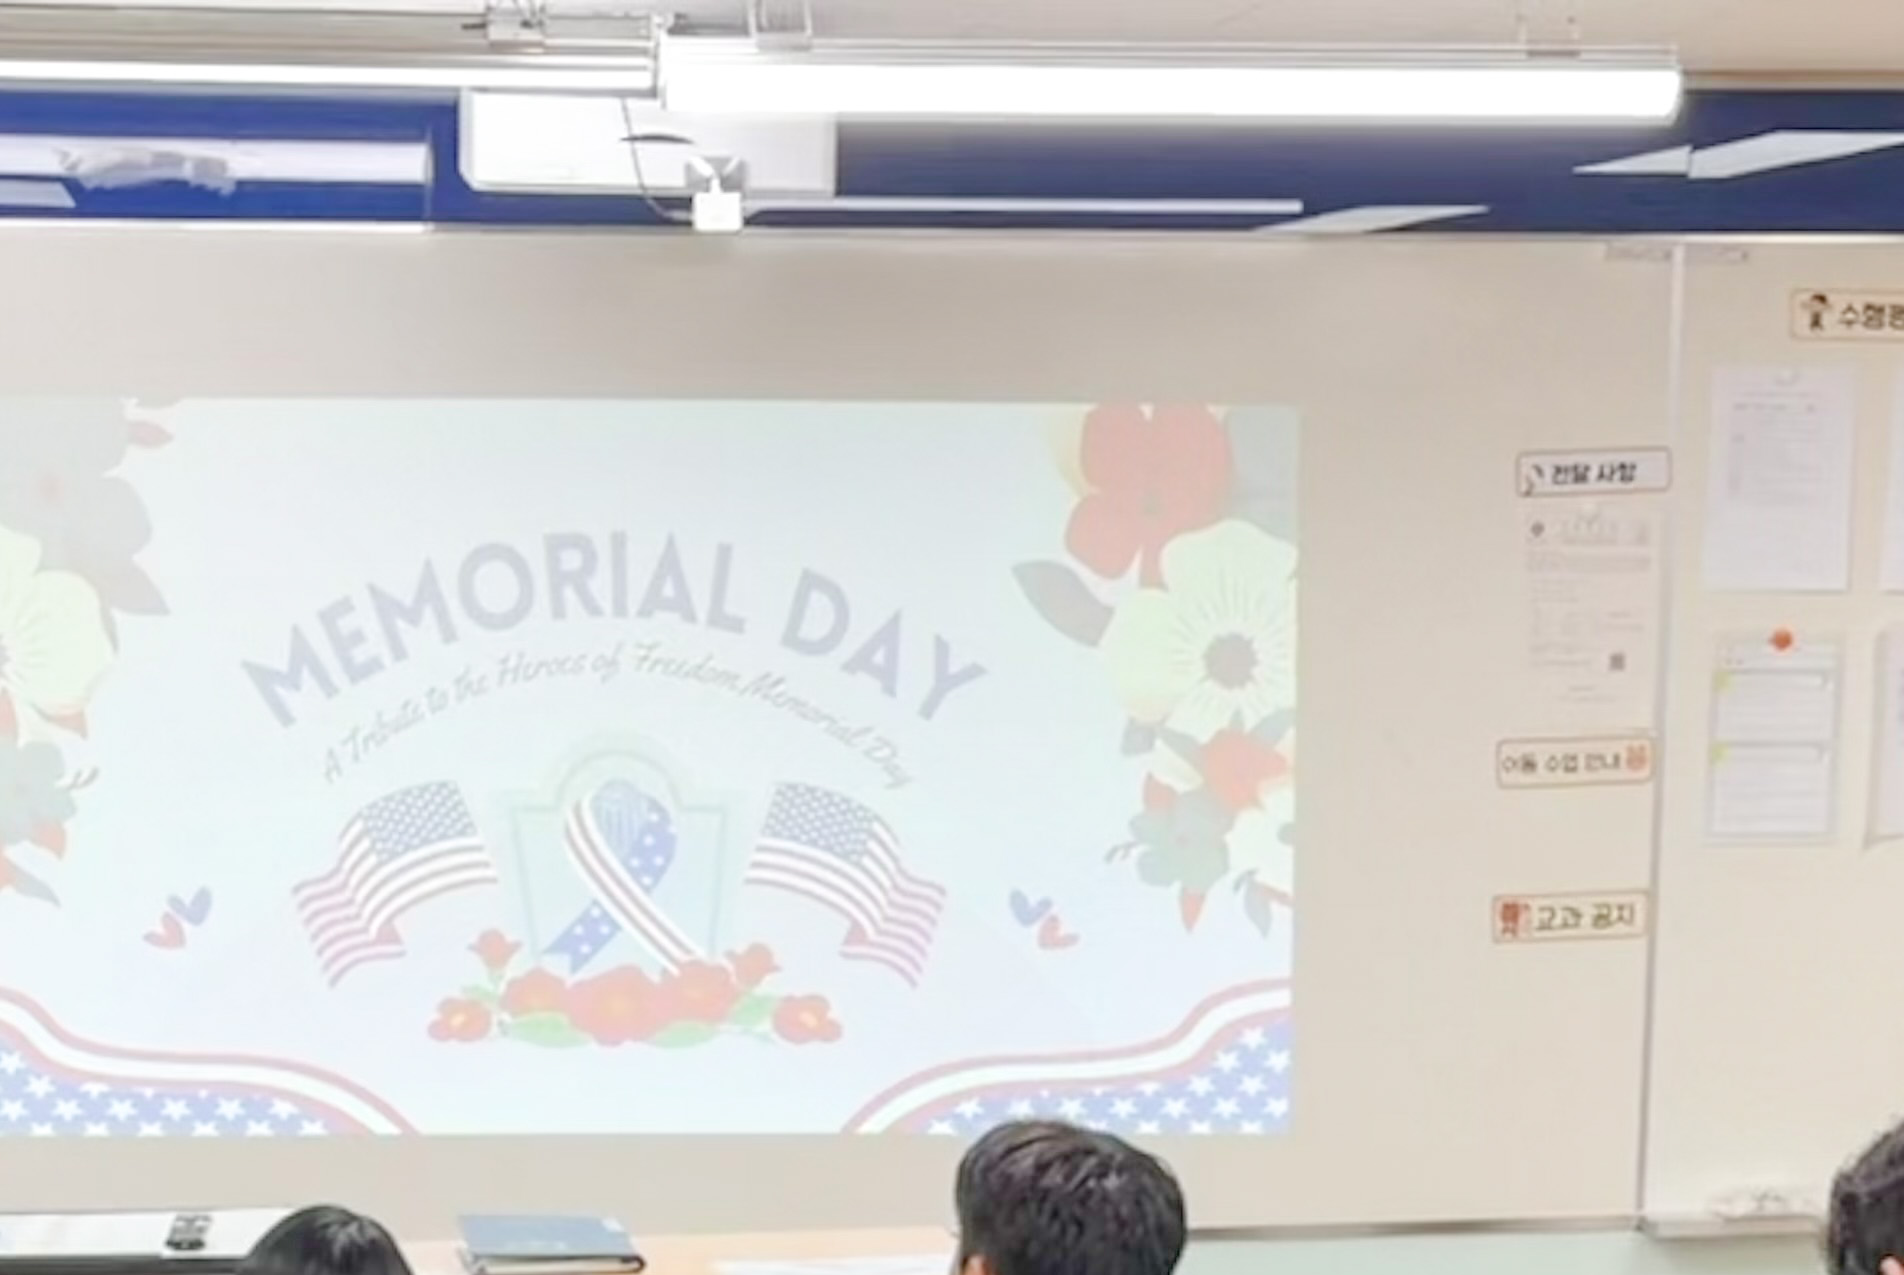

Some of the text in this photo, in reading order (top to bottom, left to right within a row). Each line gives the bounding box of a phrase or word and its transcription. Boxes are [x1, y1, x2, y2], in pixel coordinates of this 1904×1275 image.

[241, 530, 988, 728] MEMORIAL DAY
[340, 698, 426, 764] Tribute
[425, 685, 448, 714] to
[452, 663, 489, 704] the
[496, 650, 587, 688] Heroes
[590, 640, 625, 685] of
[632, 641, 741, 693] Freedom
[738, 671, 874, 748] Memorial
[862, 735, 915, 790] Day
[1592, 902, 1635, 930] 공지
